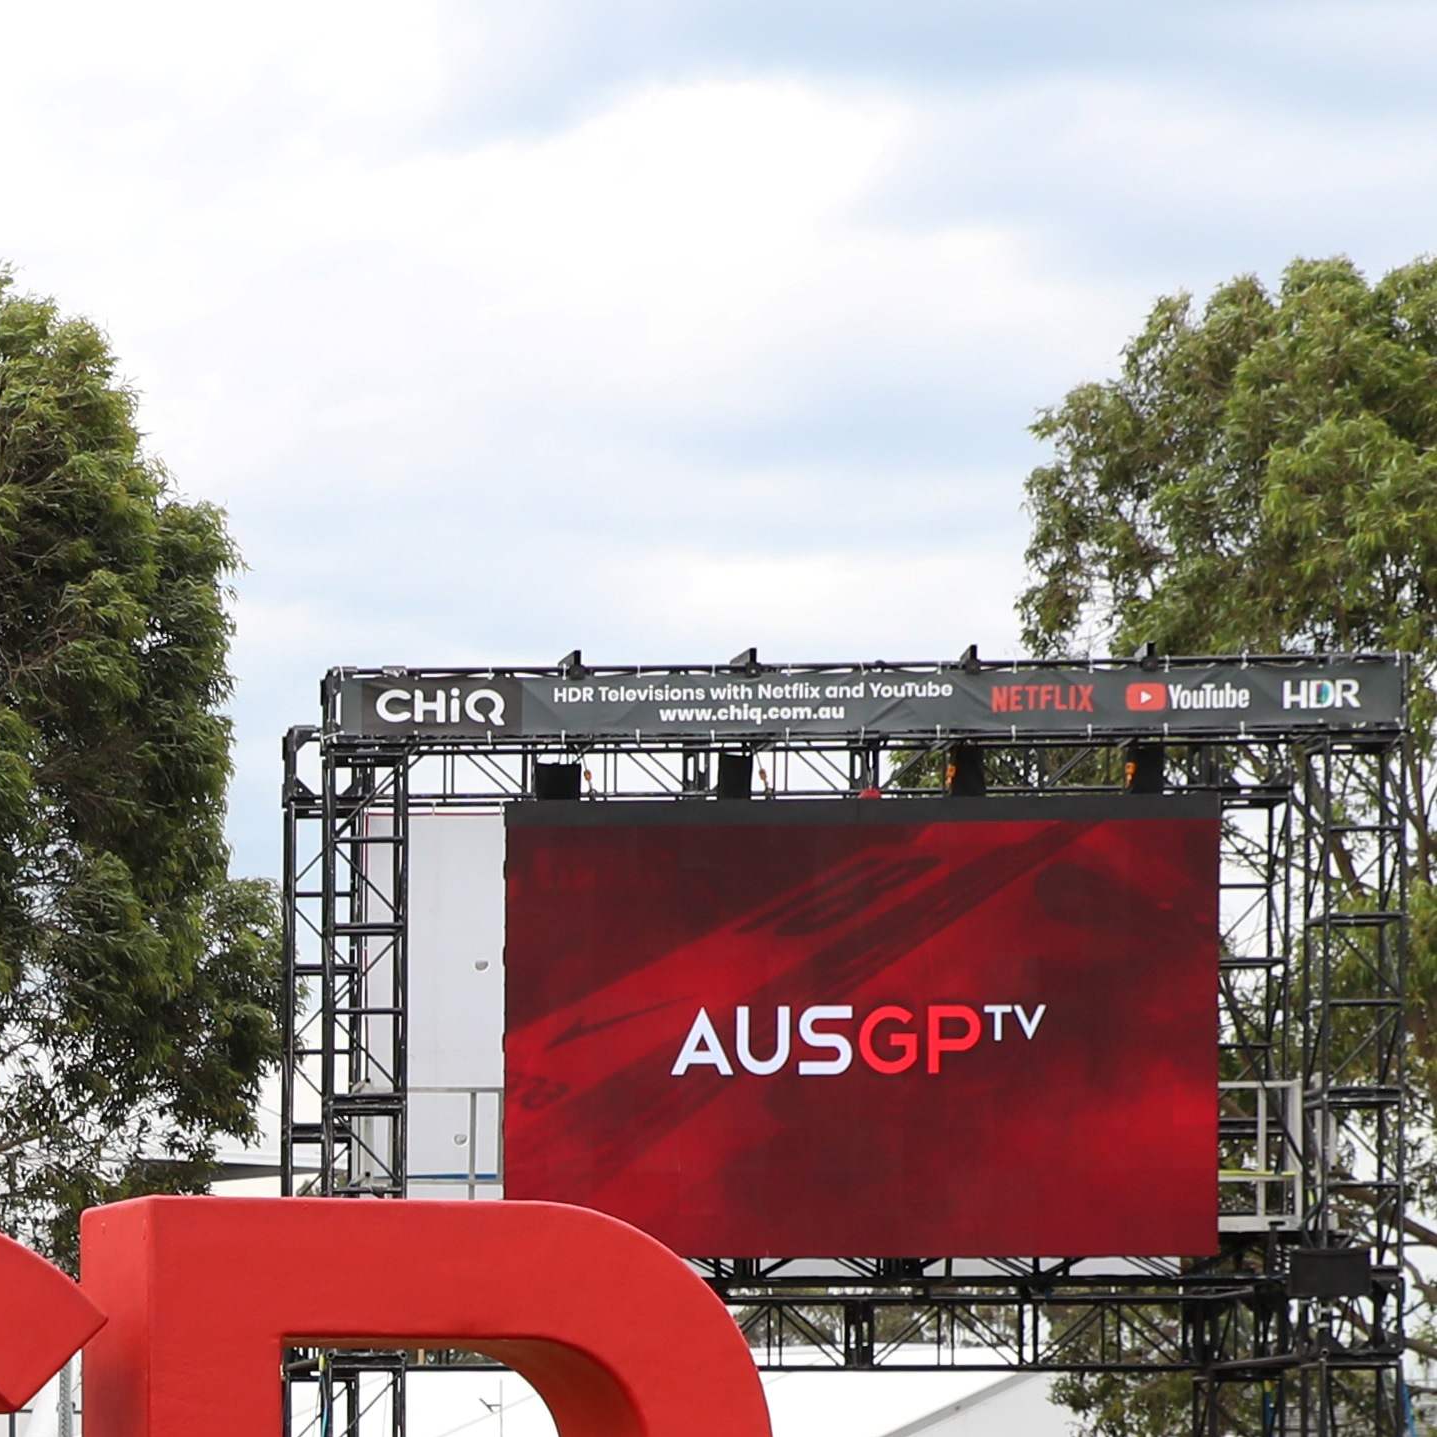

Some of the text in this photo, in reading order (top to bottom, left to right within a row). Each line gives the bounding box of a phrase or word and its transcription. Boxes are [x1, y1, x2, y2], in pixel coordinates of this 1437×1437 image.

[375, 687, 506, 726] CHiQ
[553, 681, 954, 703] HDR Televisions with Netflix and YouTube
[990, 683, 1095, 713] NETFLIX
[1167, 682, 1252, 710] YouTube
[1282, 679, 1362, 710] HDR
[659, 704, 846, 725] www.chiq.com.au
